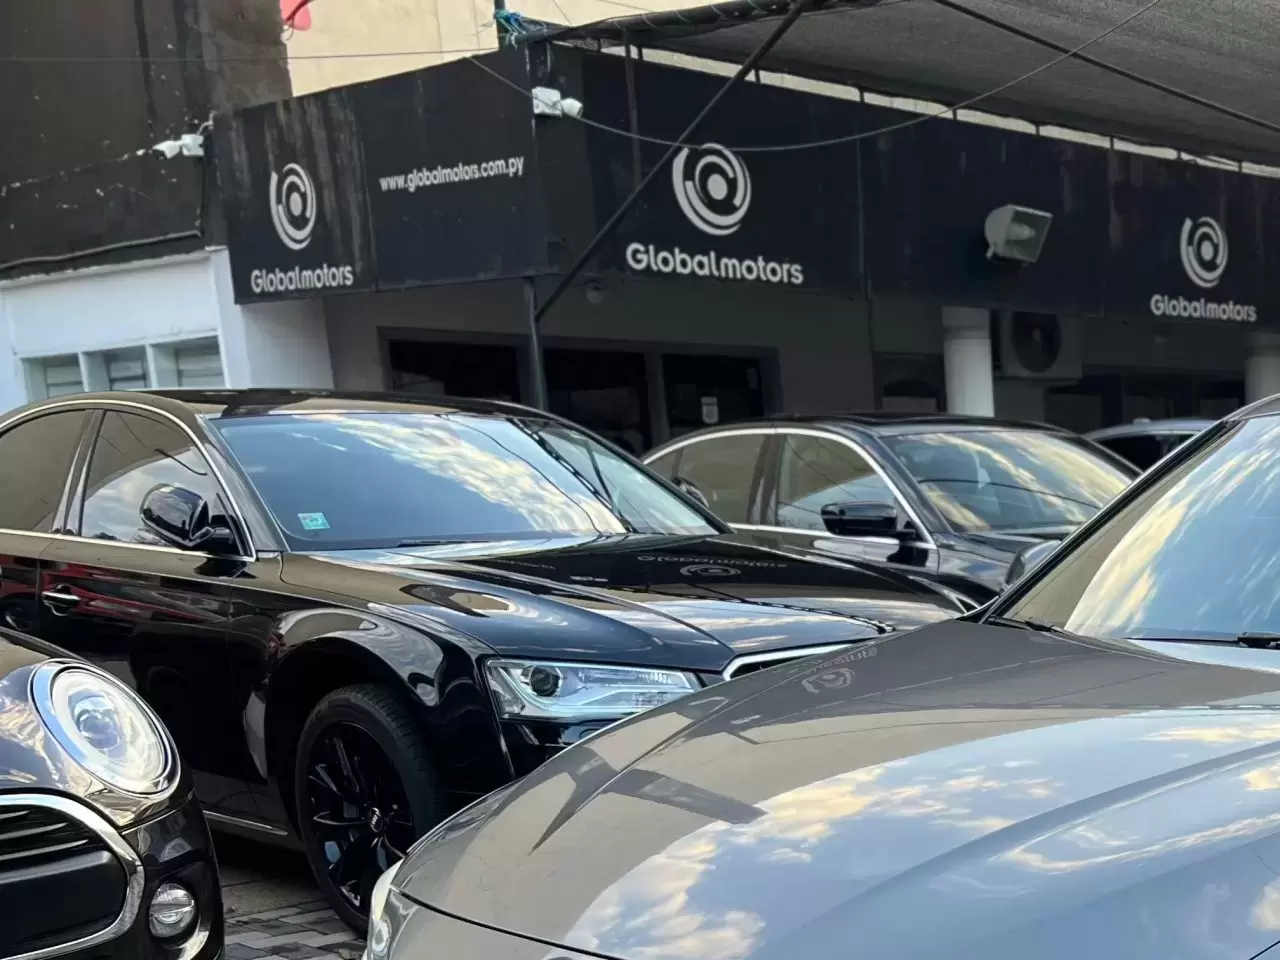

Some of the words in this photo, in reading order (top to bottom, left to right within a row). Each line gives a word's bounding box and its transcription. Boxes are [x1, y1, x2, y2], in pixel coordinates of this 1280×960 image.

[379, 156, 524, 193] www.globalmotors.com.py
[250, 263, 354, 293] Globalmotors
[625, 242, 804, 285] Globalmotors
[1150, 293, 1258, 322] Globalmotors
